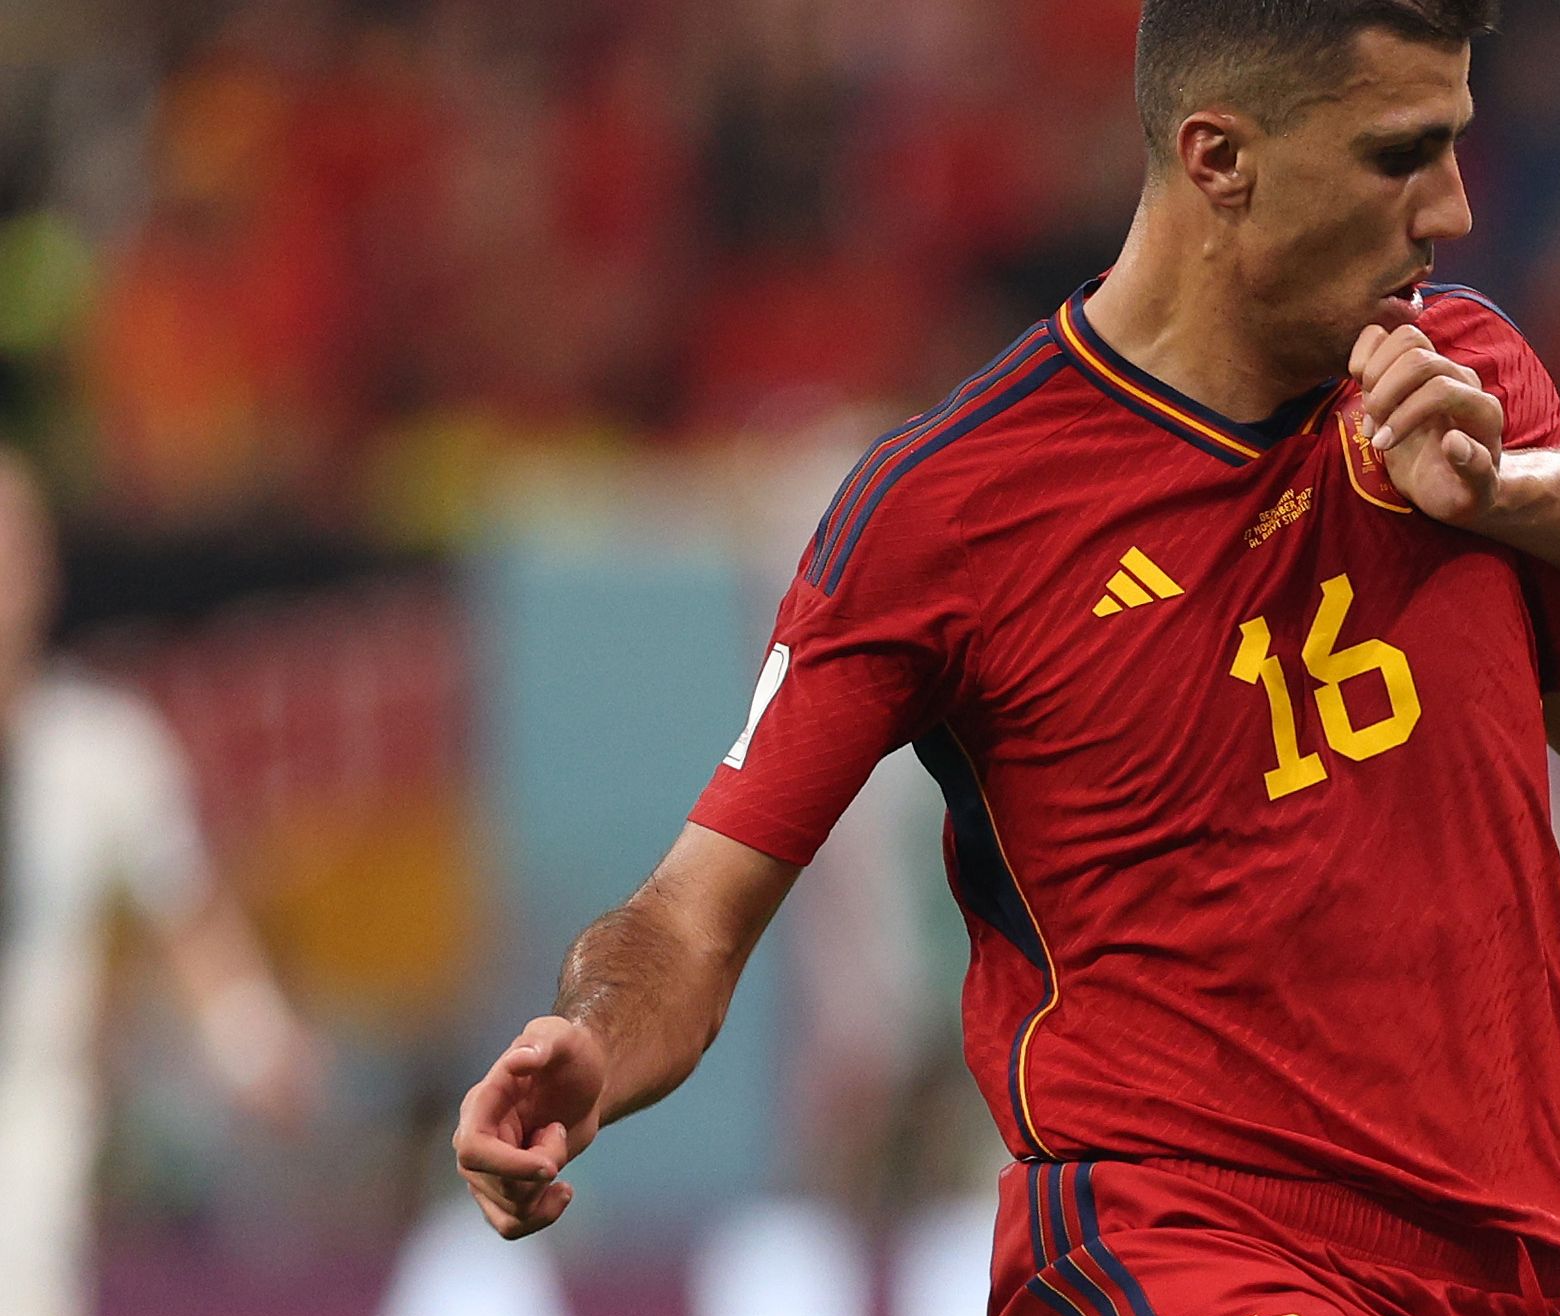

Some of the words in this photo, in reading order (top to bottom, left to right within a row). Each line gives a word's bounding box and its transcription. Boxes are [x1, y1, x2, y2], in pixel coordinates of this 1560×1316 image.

[1258, 488, 1295, 523] GENY
[1281, 499, 1312, 526] STAIU
[1228, 572, 1422, 801] 16
